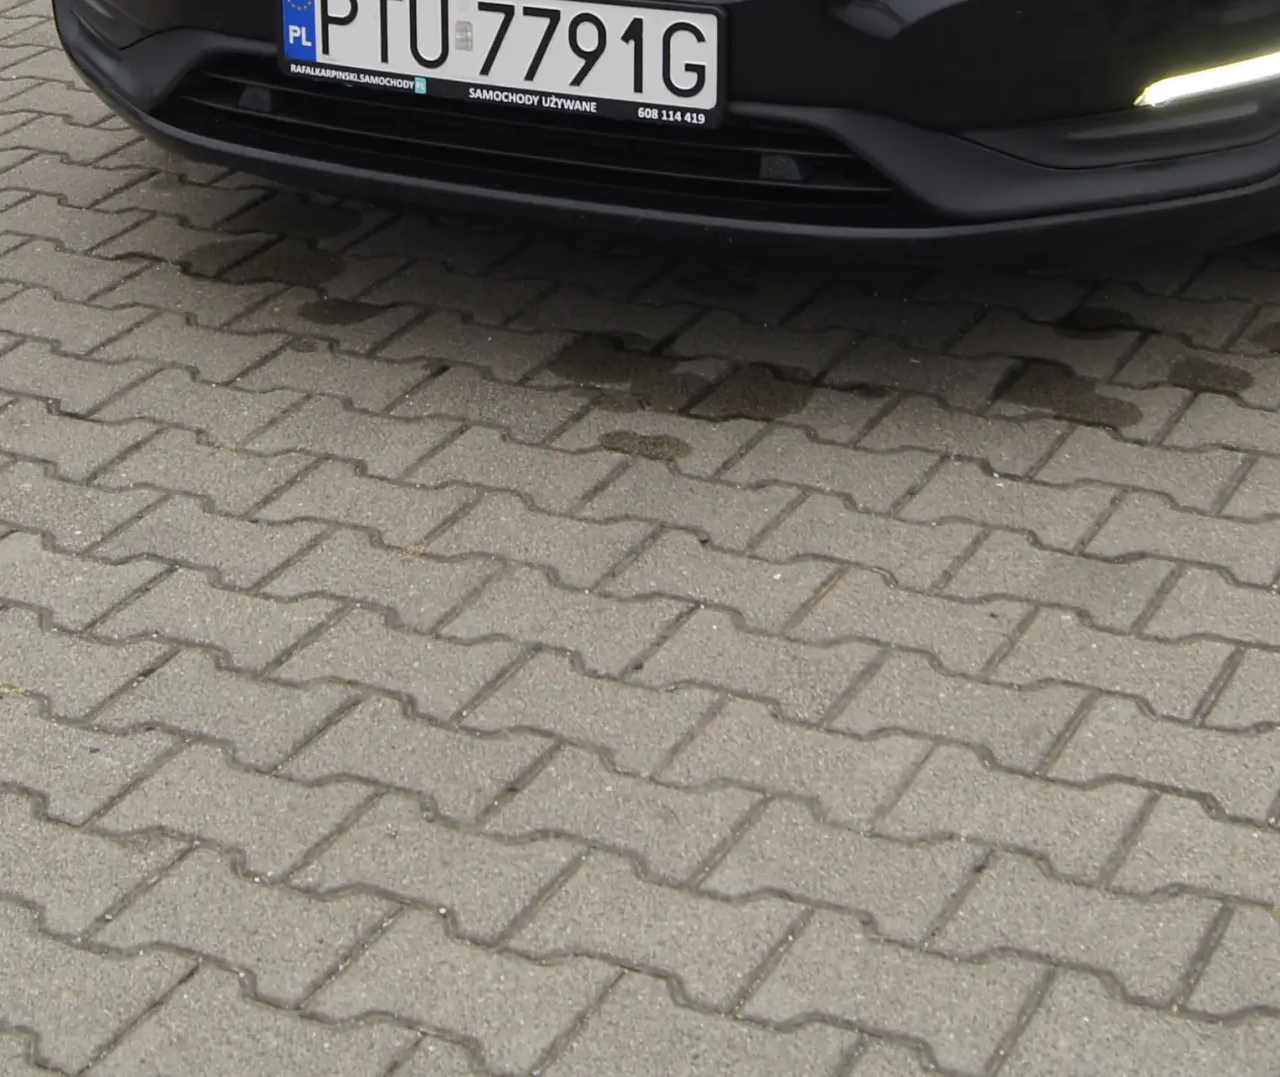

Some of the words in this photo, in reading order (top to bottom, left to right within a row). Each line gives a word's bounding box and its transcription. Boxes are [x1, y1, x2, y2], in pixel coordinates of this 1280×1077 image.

[288, 24, 312, 47] PL
[477, 0, 708, 98] 7791G
[468, 87, 540, 107] SAMOCHODY
[541, 95, 597, 113] UŻYWANE
[637, 107, 658, 120] 608
[661, 110, 682, 122] 114
[683, 112, 705, 124] 419
